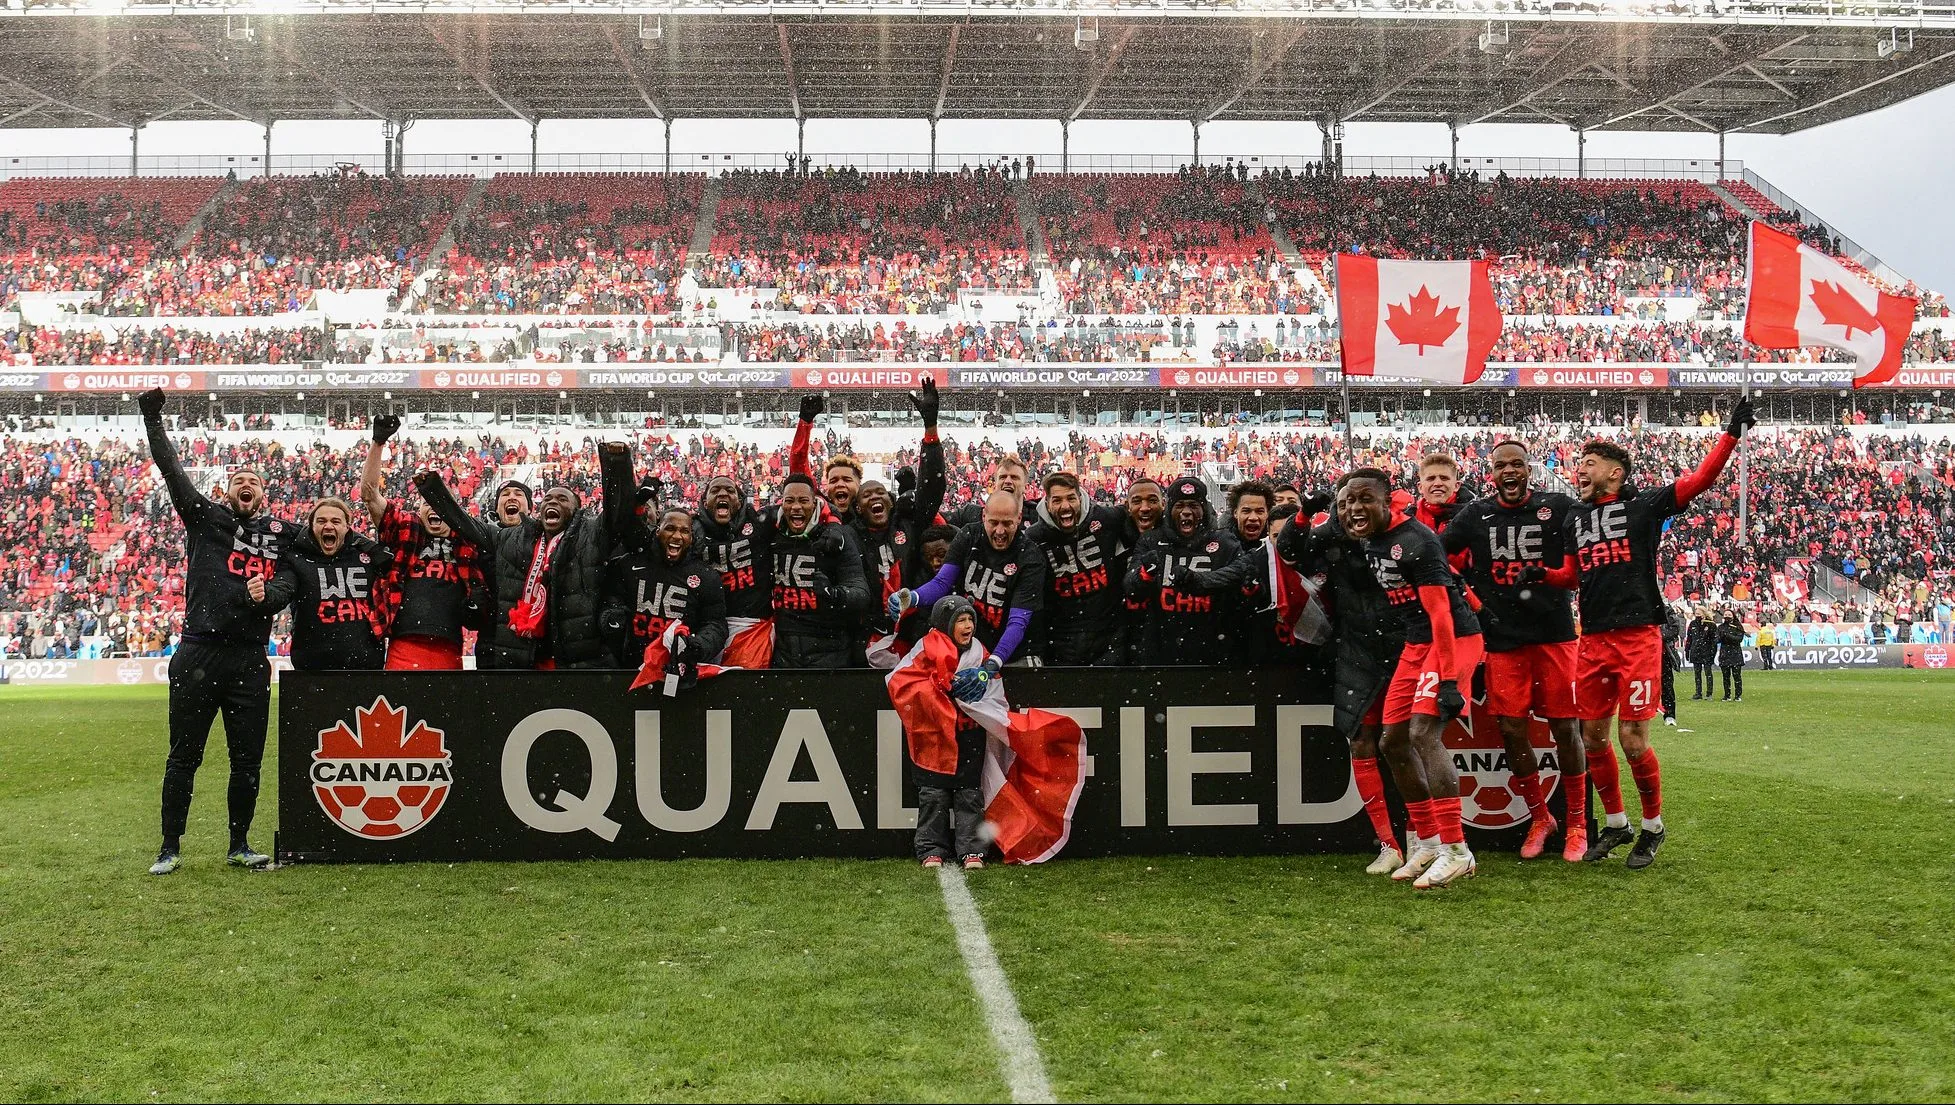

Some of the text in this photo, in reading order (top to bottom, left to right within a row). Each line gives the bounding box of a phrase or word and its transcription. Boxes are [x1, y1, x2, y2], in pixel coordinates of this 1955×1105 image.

[84, 375, 170, 388] QUALIFIED
[217, 375, 249, 386] FIFA
[247, 374, 295, 386] WORLD
[297, 374, 322, 386] CUP
[455, 373, 540, 387] QUALIFIED
[589, 372, 618, 384] FIFA
[618, 372, 667, 384] WORLD
[669, 372, 694, 384] CUP
[828, 372, 912, 385] QUALIFIED
[960, 372, 987, 384] FIFA
[987, 372, 1037, 384] WORLD
[1038, 372, 1064, 383] CUP
[1195, 372, 1278, 384] QUALIFIED
[1553, 372, 1634, 385] QUALIFIED
[1680, 371, 1707, 383] FIFA
[1752, 372, 1777, 383] CUP
[1575, 503, 1629, 549] WE
[233, 524, 279, 560] WE
[1489, 524, 1543, 560] WE
[227, 551, 277, 582] CAN
[1047, 534, 1104, 578] WE
[1578, 538, 1633, 573] CAN
[317, 566, 369, 600] WE
[410, 559, 459, 584] CAN
[720, 565, 756, 593] AN
[773, 553, 817, 589] WE
[965, 560, 1008, 608] WE
[1055, 563, 1110, 598] CAN
[316, 598, 372, 624] CAN
[636, 578, 689, 619] WE
[772, 586, 818, 611] CAN
[632, 614, 676, 640] CA
[1414, 671, 1439, 698] 22
[1629, 680, 1652, 706] 21
[312, 762, 450, 783] CANADA
[500, 704, 1366, 843] QUALIED
[1453, 751, 1559, 773] ANAA
